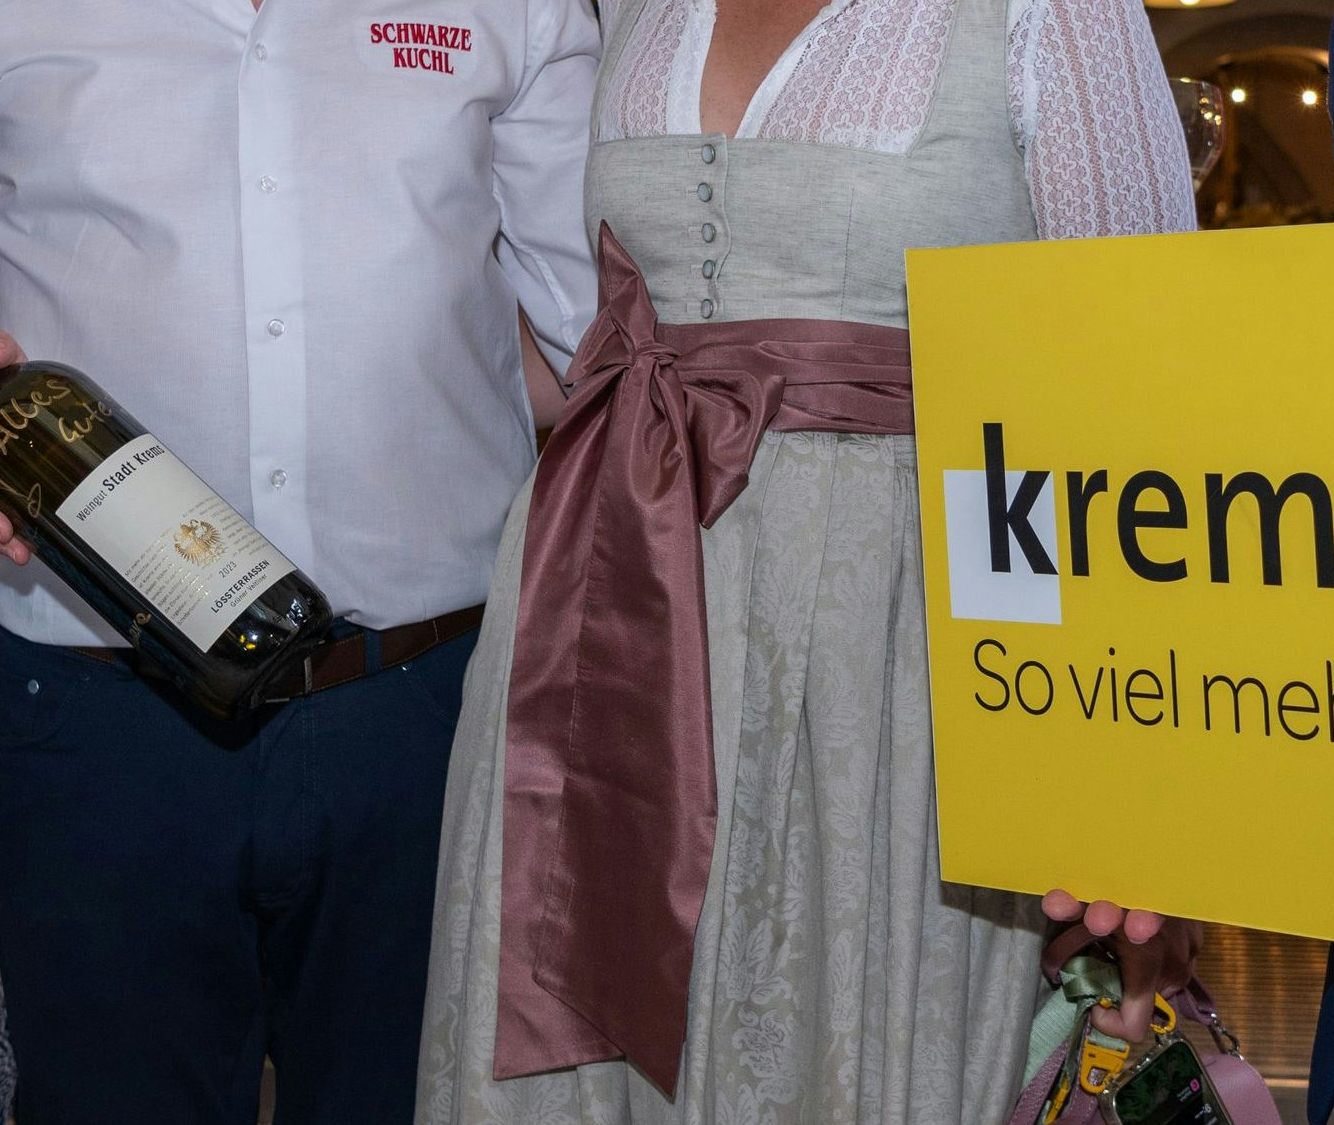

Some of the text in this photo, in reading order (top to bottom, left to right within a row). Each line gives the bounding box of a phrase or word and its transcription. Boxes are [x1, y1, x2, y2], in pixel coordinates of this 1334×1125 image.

[370, 22, 472, 52] SCHWARZE
[393, 47, 455, 75] KUCHL
[75, 490, 108, 521] Weingut
[102, 460, 137, 492] Stadt
[133, 445, 165, 465] Krems
[218, 561, 237, 578] 2023
[210, 559, 271, 613] LÖSSTERRASSEN
[230, 590, 248, 607] Grüner
[973, 638, 1055, 717] So
[1068, 647, 1180, 729] viel
